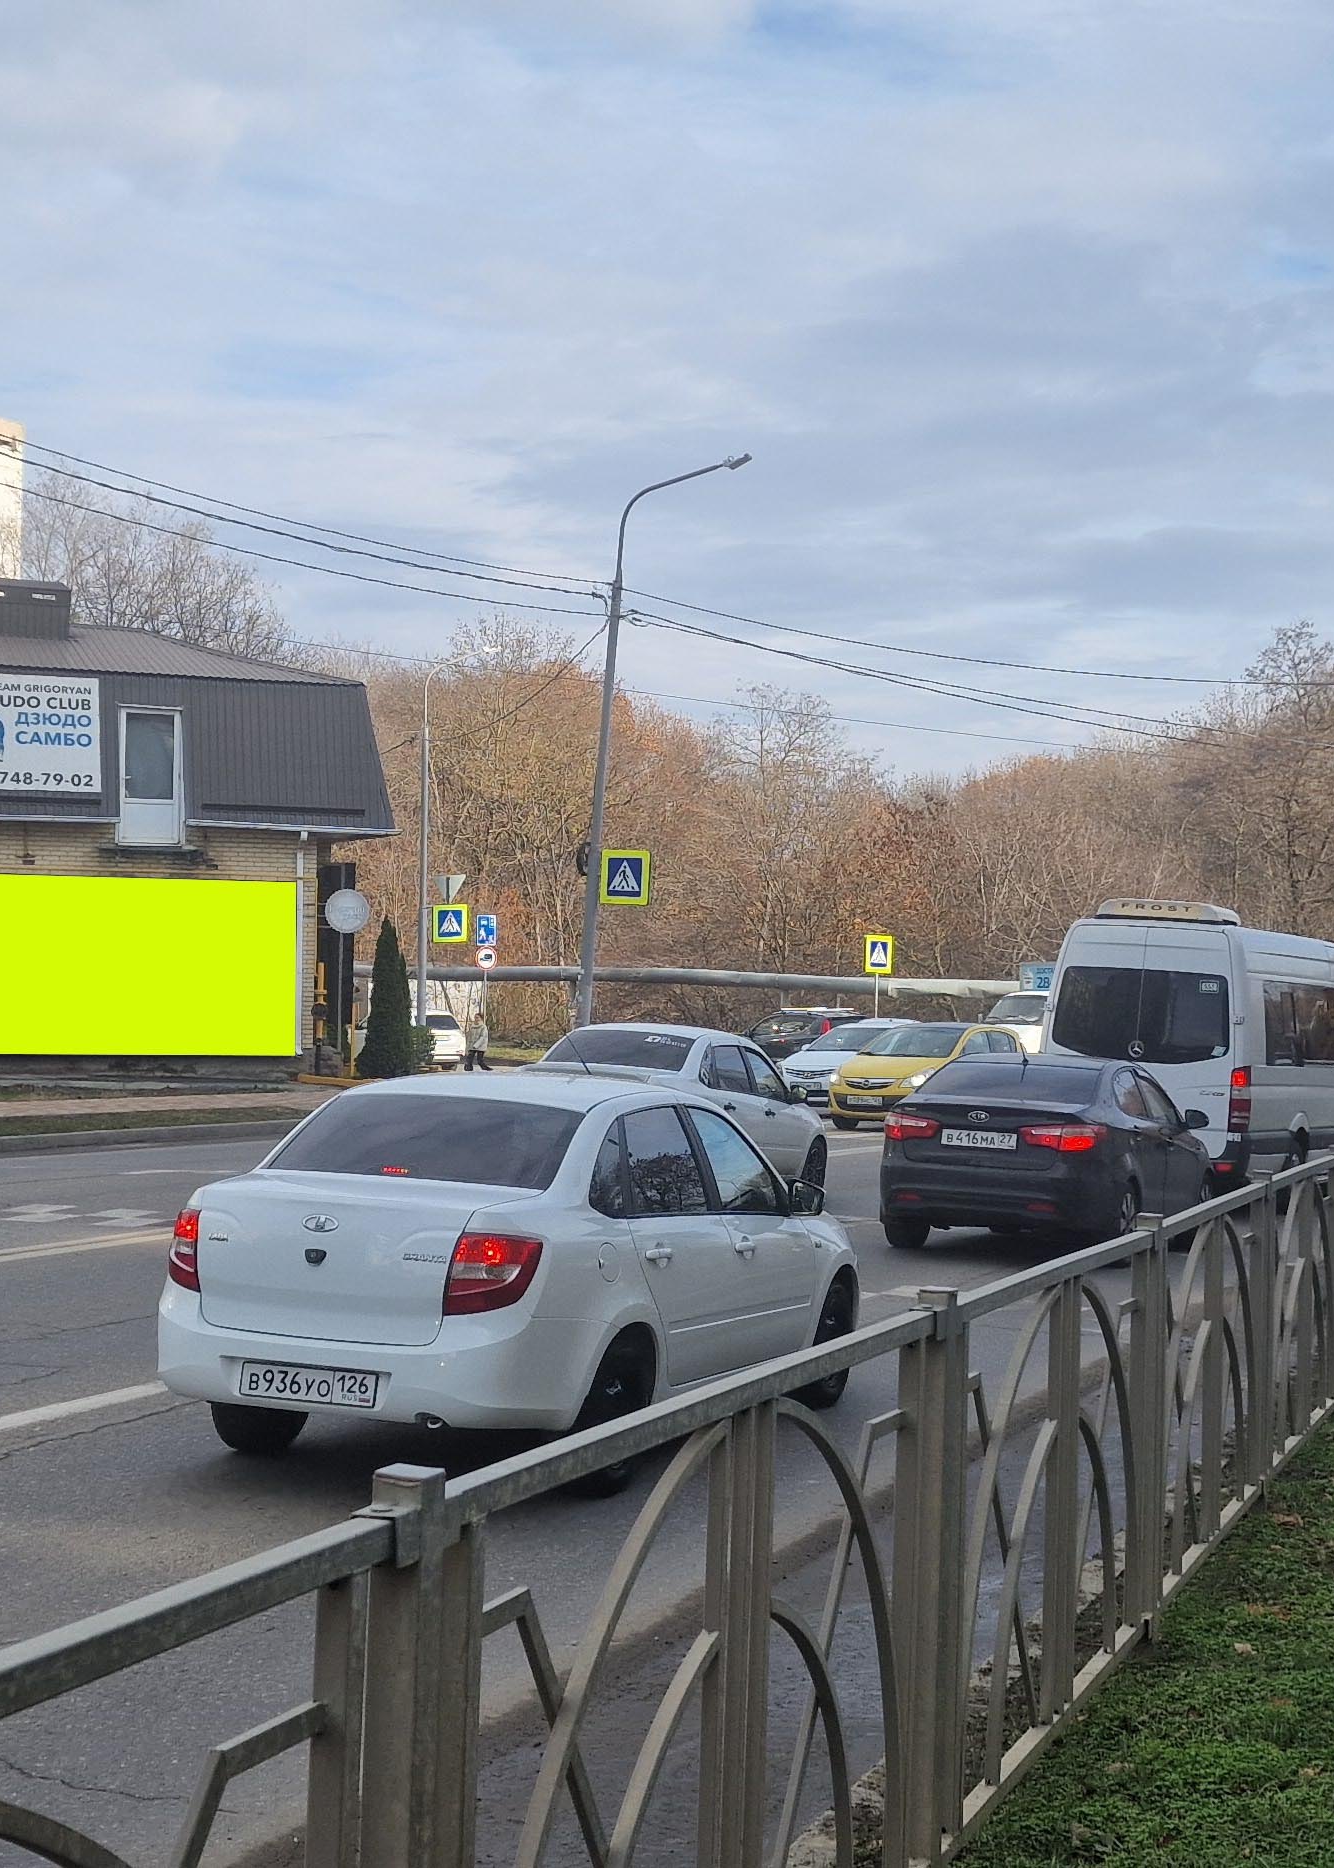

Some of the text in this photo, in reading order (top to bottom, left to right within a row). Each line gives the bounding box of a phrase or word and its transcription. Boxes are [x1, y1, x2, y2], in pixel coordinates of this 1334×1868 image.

[24, 684, 92, 695] GRIGORYAN
[46, 697, 92, 711] CLUB
[14, 711, 92, 728] ДЗЮДО
[15, 731, 92, 747] САМБО
[1121, 903, 1192, 913] FROST
[336, 1374, 369, 1395] 126
